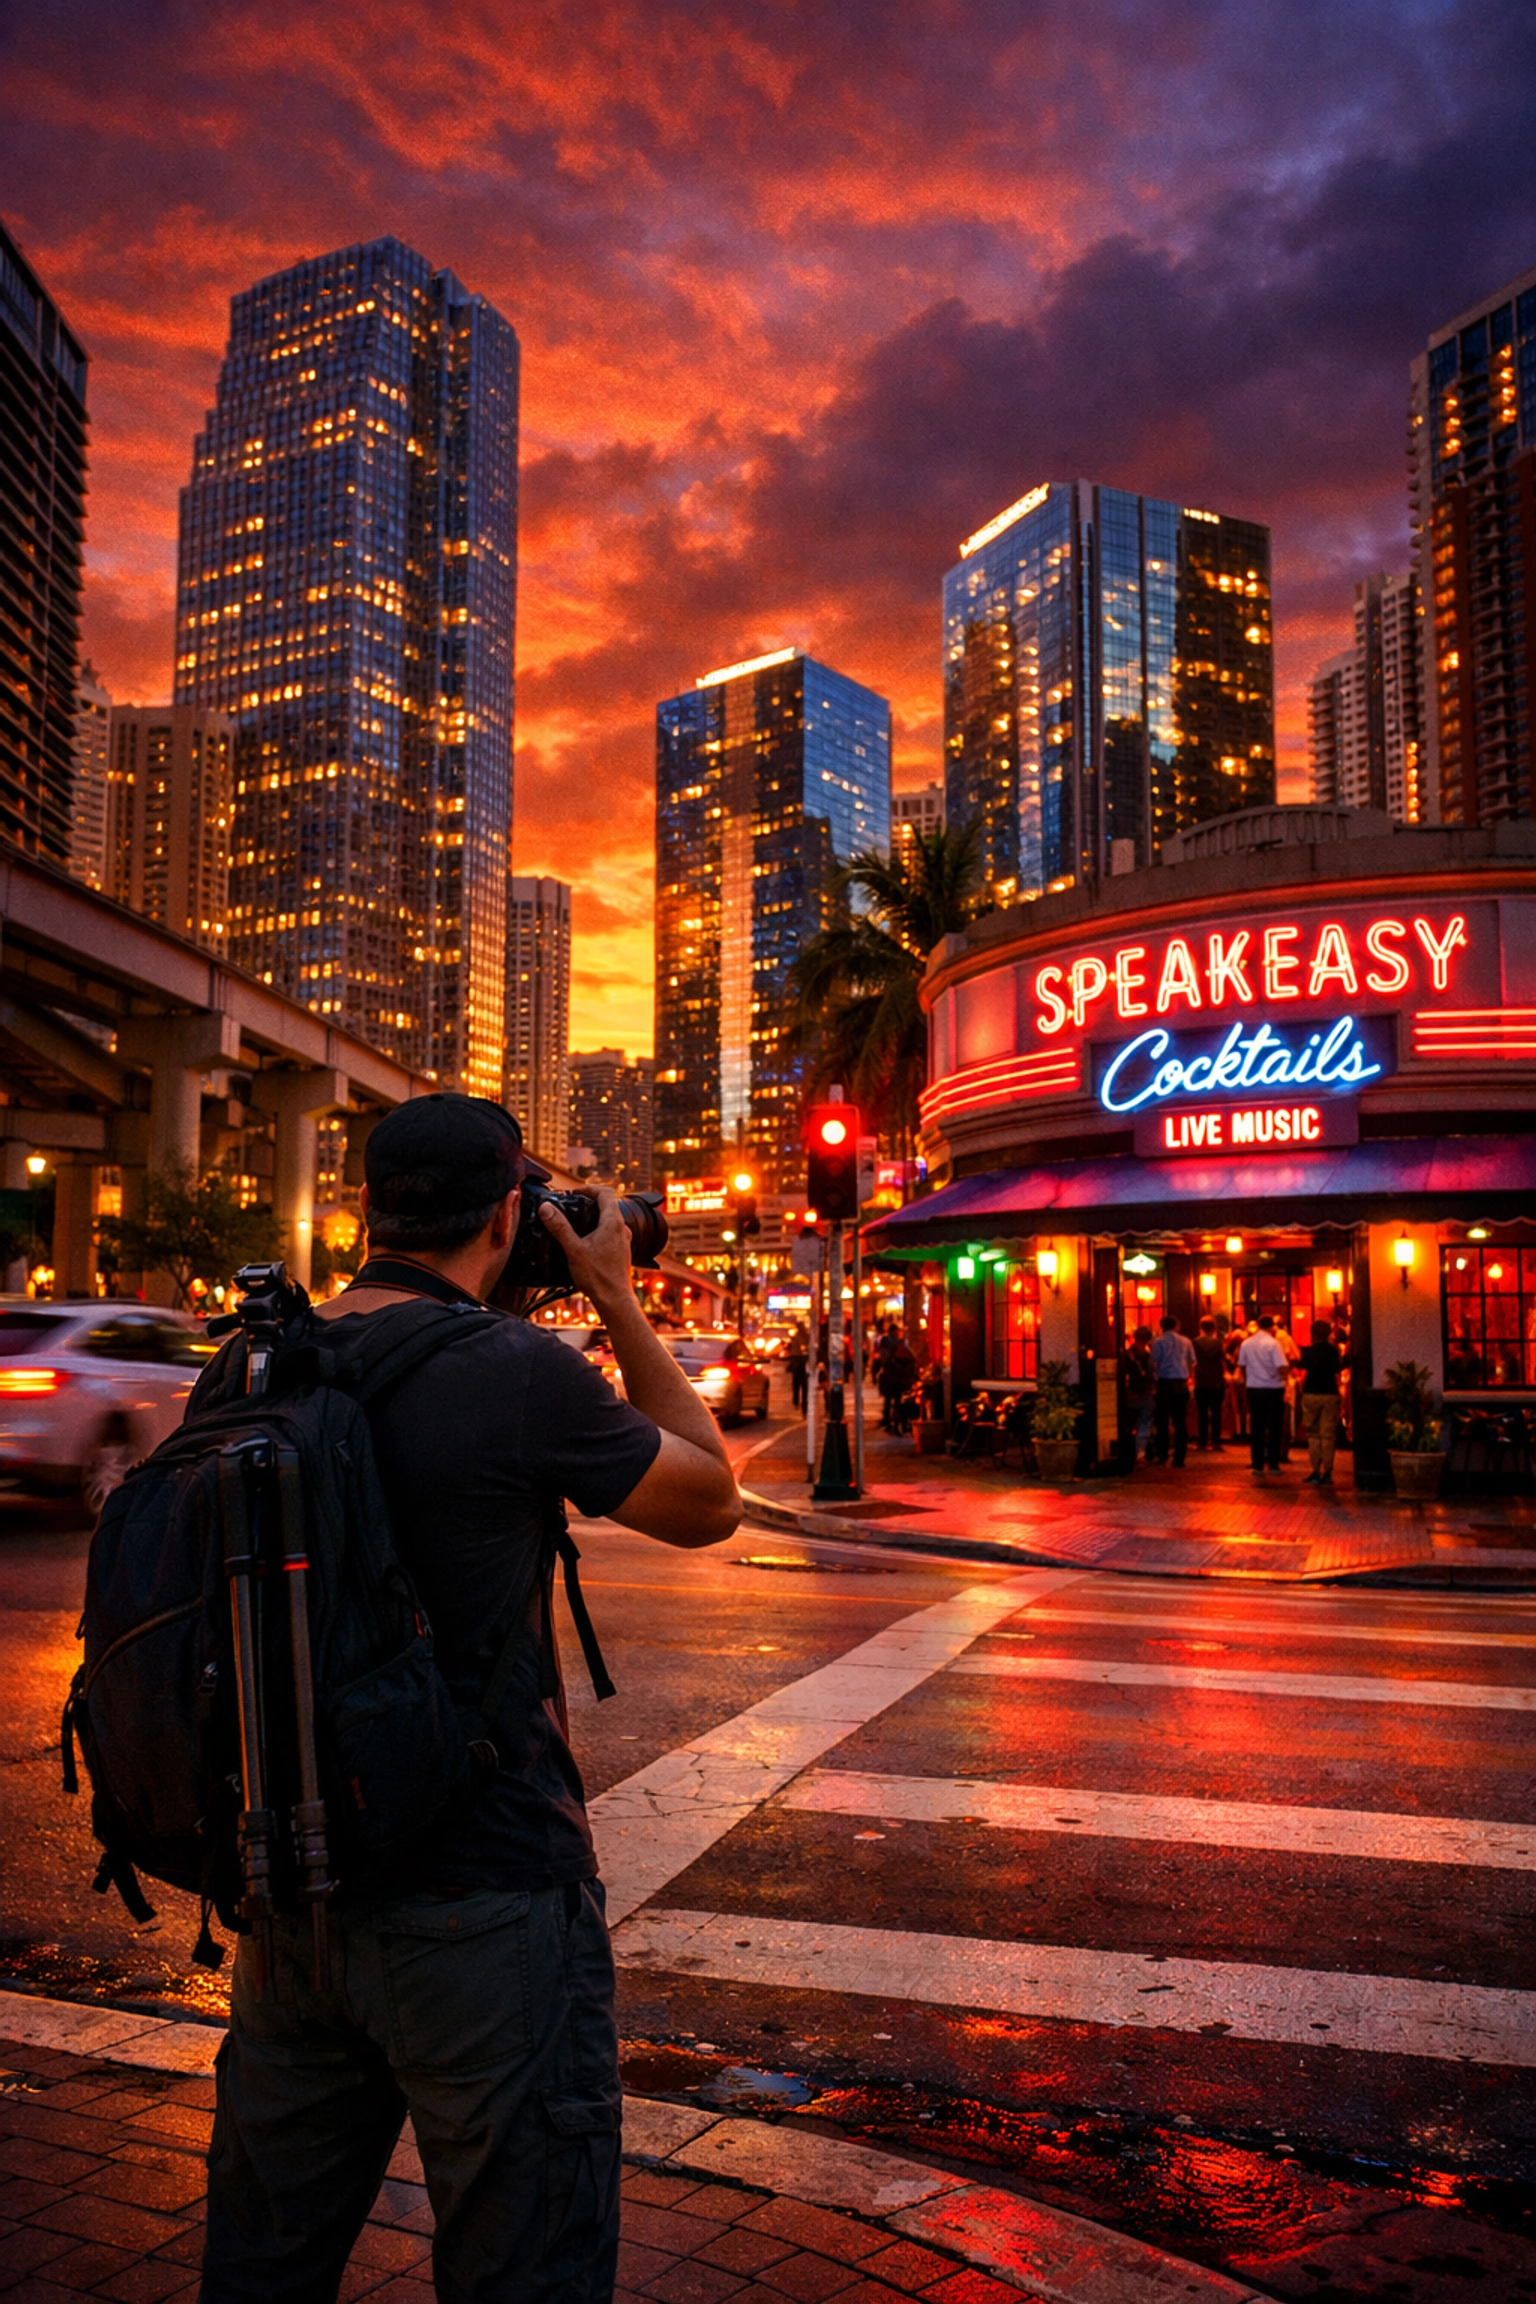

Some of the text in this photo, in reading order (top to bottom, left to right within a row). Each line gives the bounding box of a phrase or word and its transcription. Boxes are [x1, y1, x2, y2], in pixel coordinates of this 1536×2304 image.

[1035, 916, 1465, 1035] SPEAKEASY
[1100, 1015, 1382, 1112] Cocktails
[1164, 1107, 1321, 1149] LIVE MUSIC
